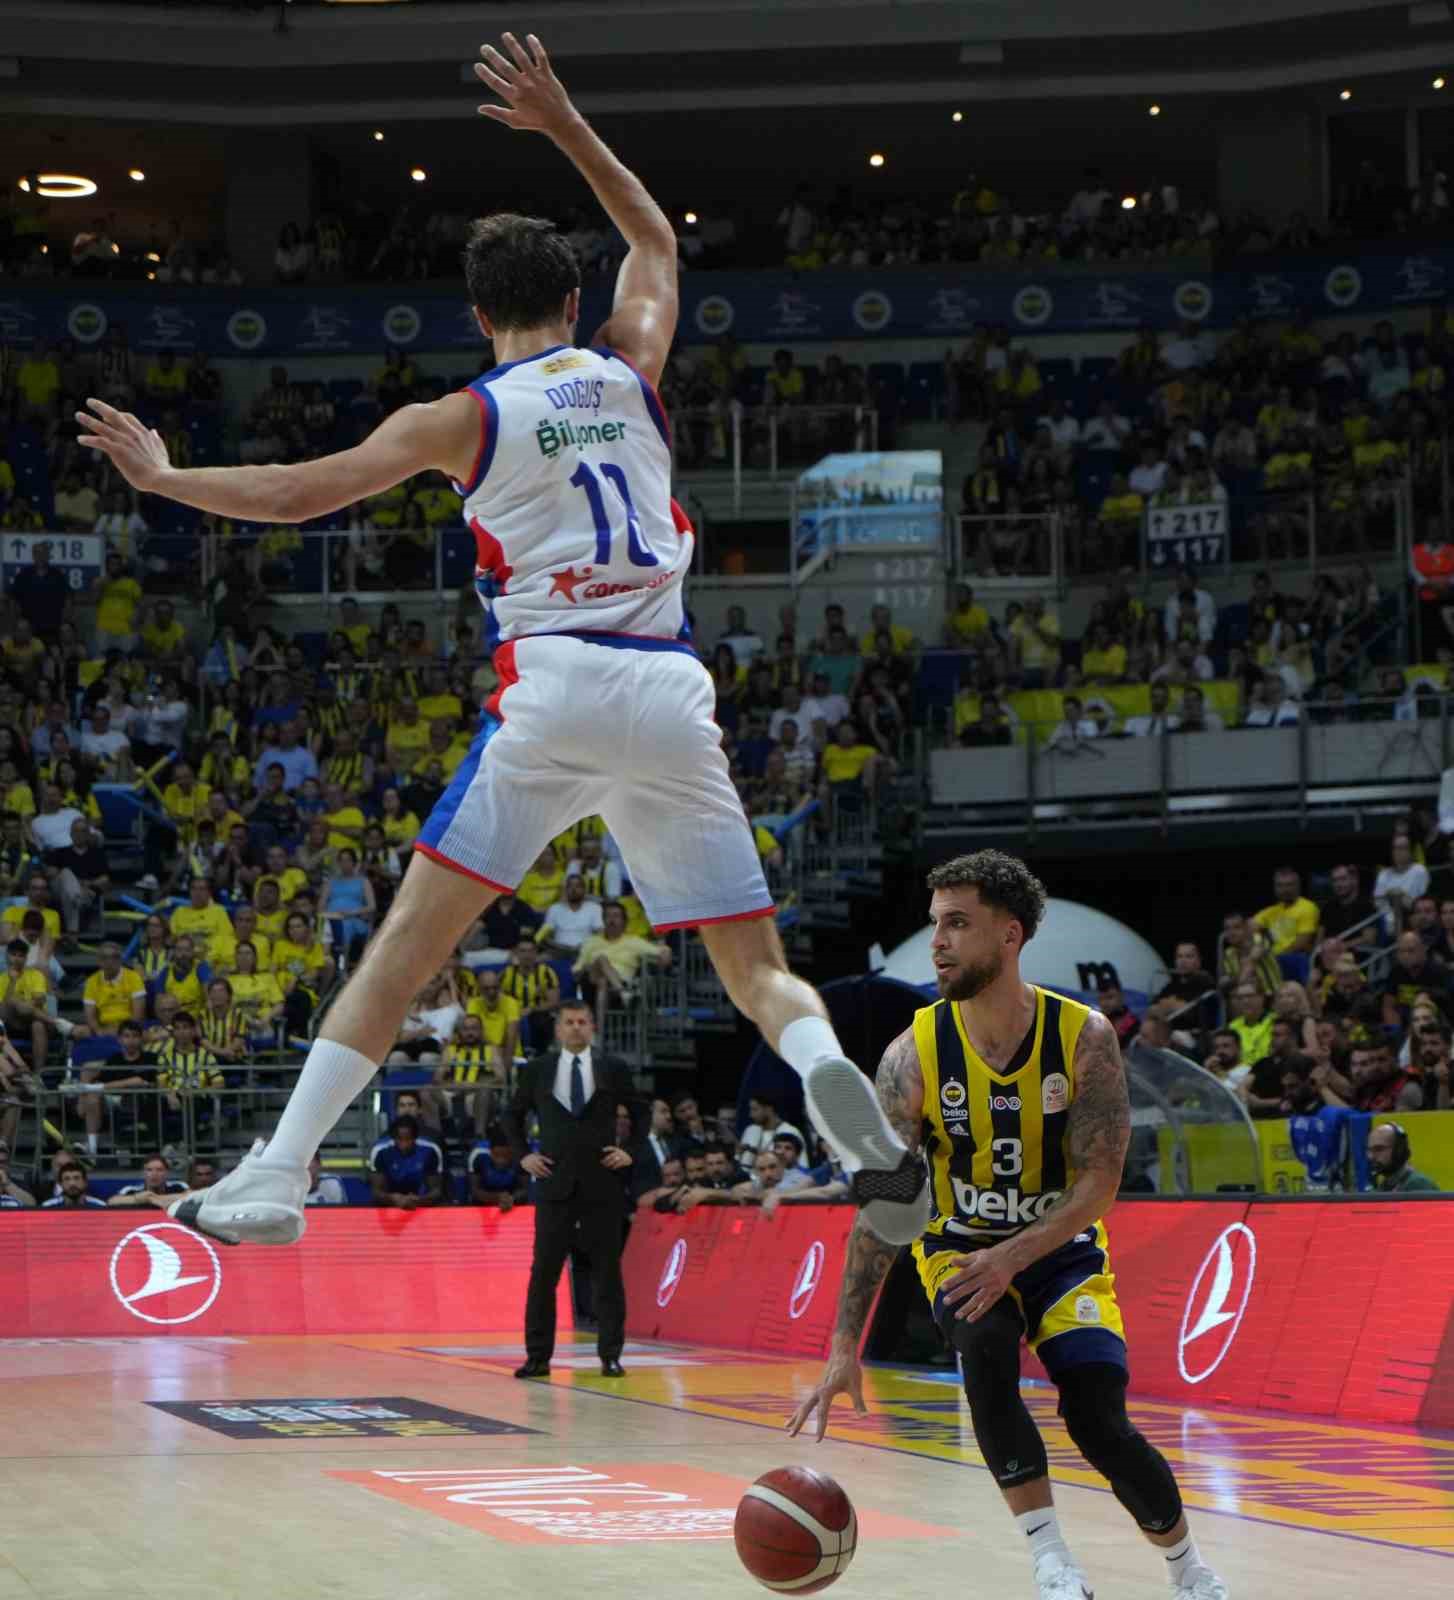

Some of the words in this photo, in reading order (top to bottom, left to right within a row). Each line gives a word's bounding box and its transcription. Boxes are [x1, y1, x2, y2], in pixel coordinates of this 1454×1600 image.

[544, 377, 604, 417] DOĞUŞ
[1173, 511, 1220, 534] 217
[1173, 539, 1220, 563] 117
[942, 1106, 969, 1118] beko
[991, 1137, 1023, 1176] 3
